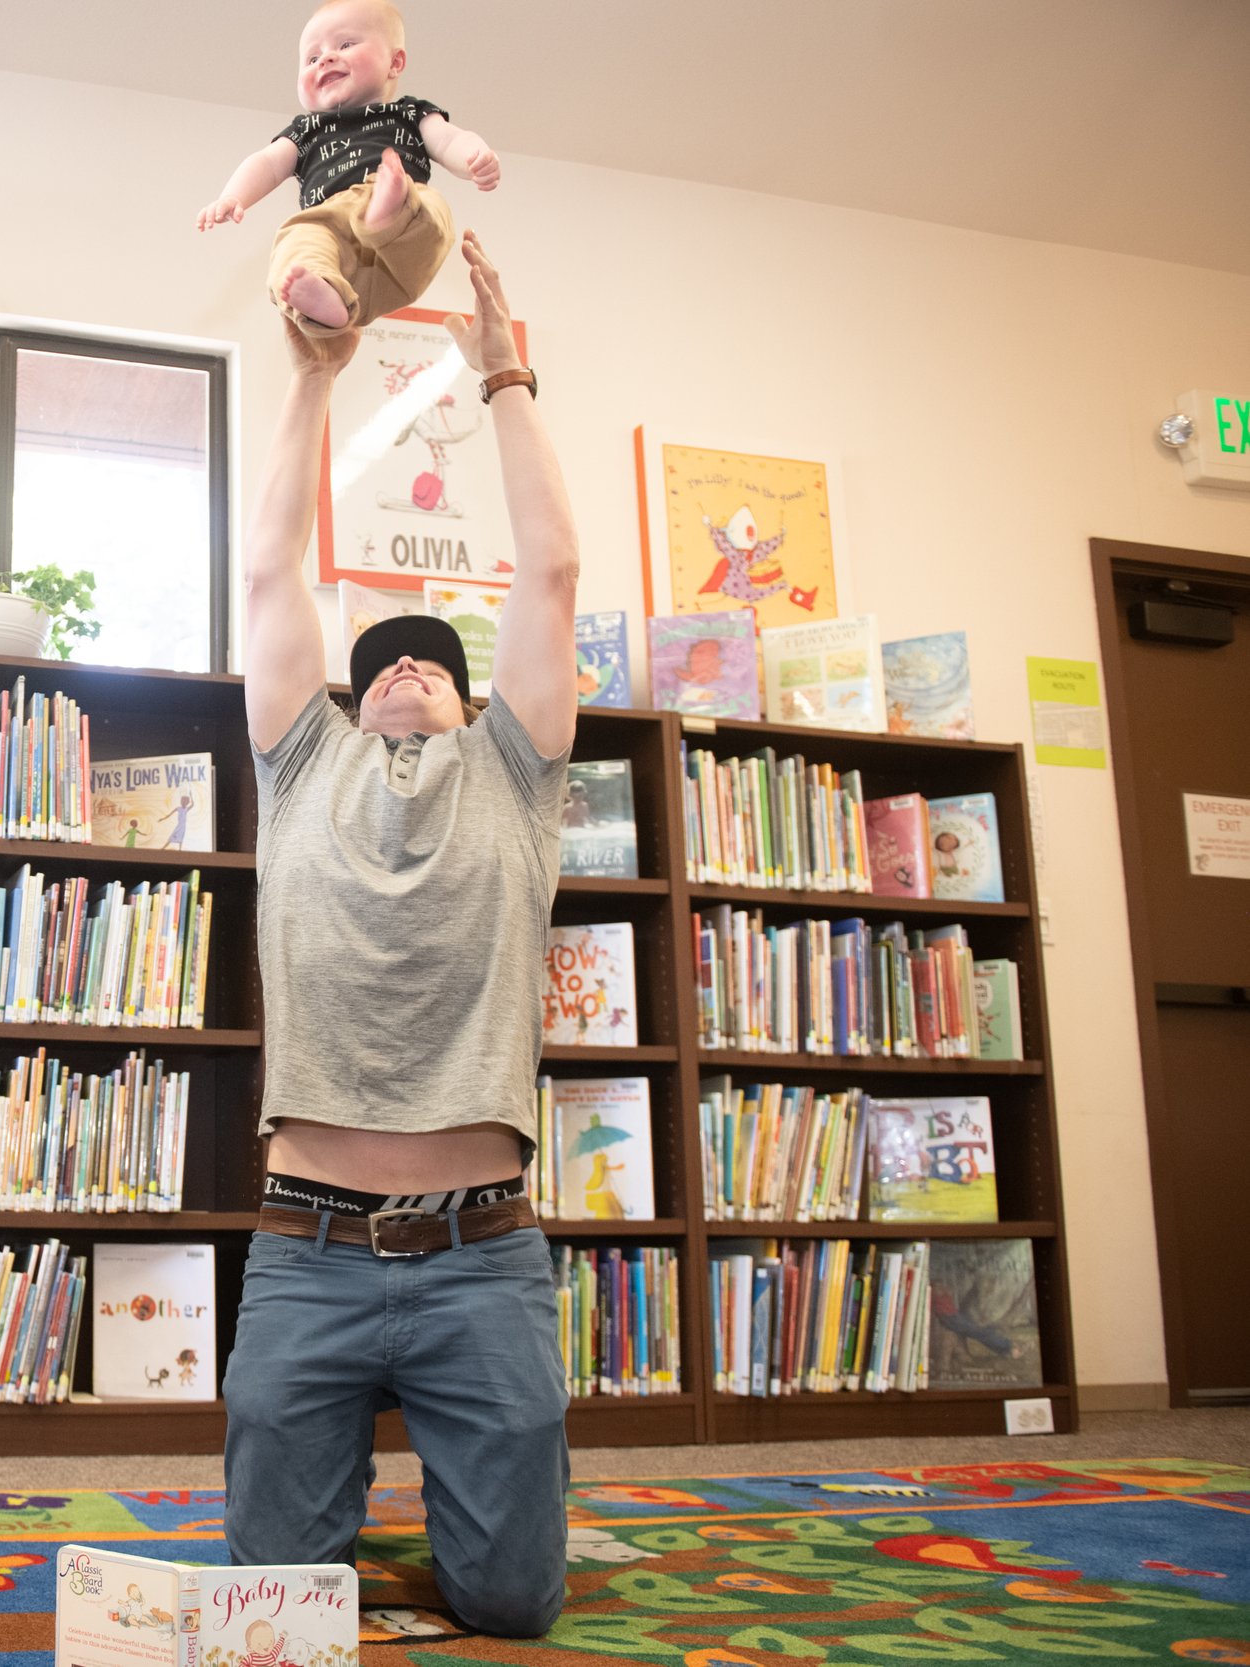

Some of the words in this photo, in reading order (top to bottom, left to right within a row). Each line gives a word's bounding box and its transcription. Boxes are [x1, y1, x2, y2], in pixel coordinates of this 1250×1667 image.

[319, 138, 350, 160] HEY
[391, 534, 472, 572] OLIVIA
[126, 766, 160, 791] LONG
[164, 763, 206, 788] WALK
[576, 847, 624, 867] RIVER
[924, 1110, 954, 1139] IS
[263, 1176, 364, 1212] Champion
[99, 1294, 207, 1321] another
[59, 1557, 76, 1577] A
[76, 1554, 102, 1575] Classic
[212, 1575, 285, 1631] Baby
[112, 1636, 140, 1648] wonderful
[141, 1641, 160, 1652] things
[187, 1636, 198, 1667] Bab
